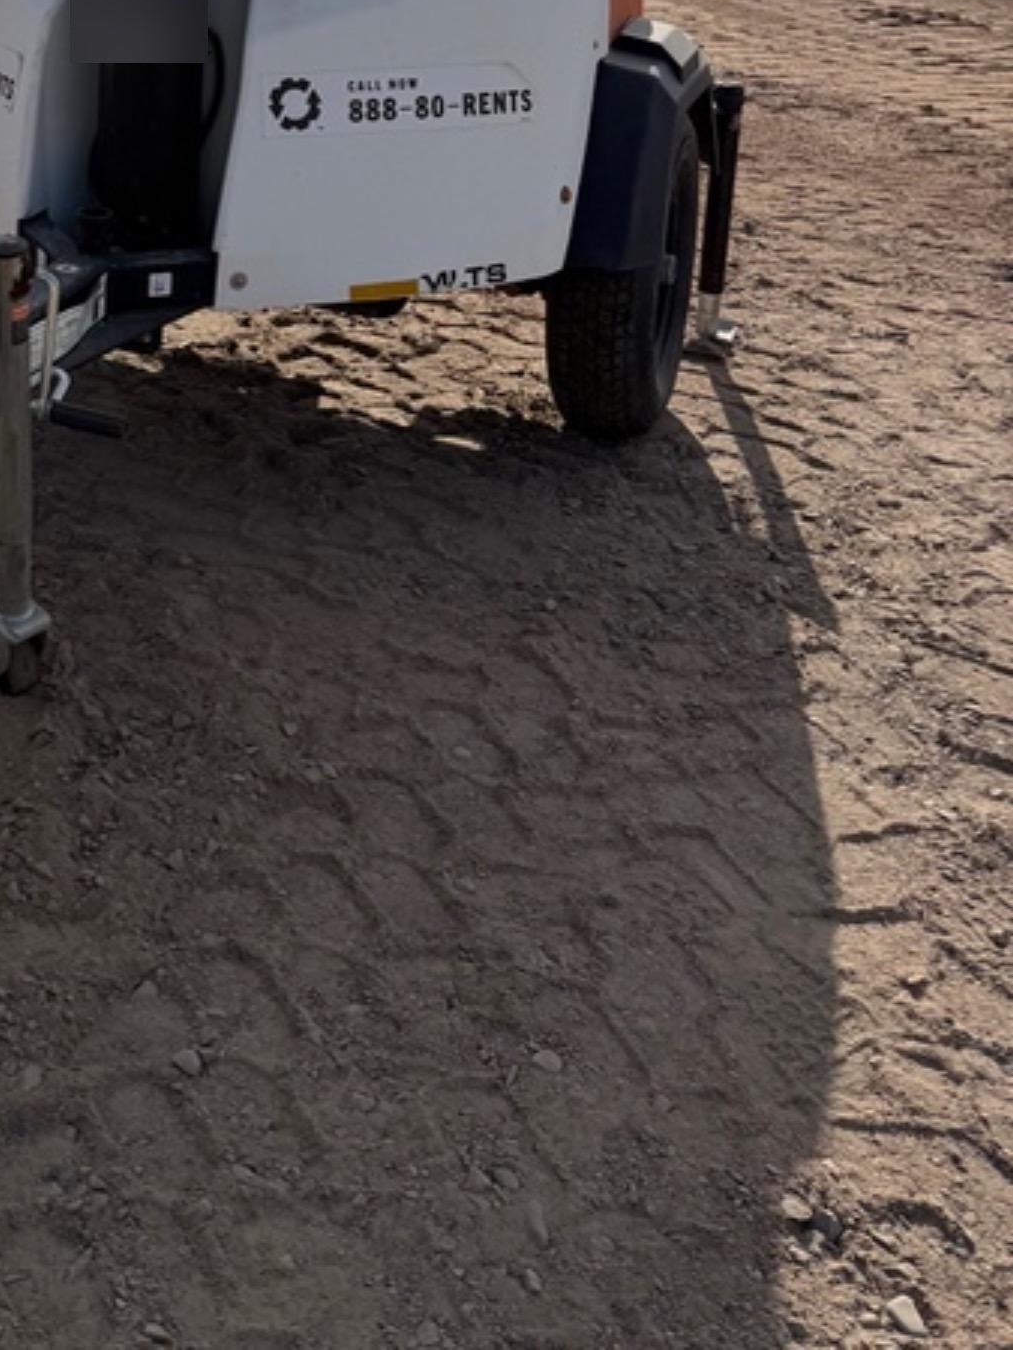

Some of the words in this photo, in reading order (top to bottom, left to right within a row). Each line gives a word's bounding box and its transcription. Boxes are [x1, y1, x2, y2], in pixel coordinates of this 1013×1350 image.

[347, 80, 381, 93] CALL
[388, 77, 419, 91] NOW
[348, 89, 533, 123] 888-80-RENTS
